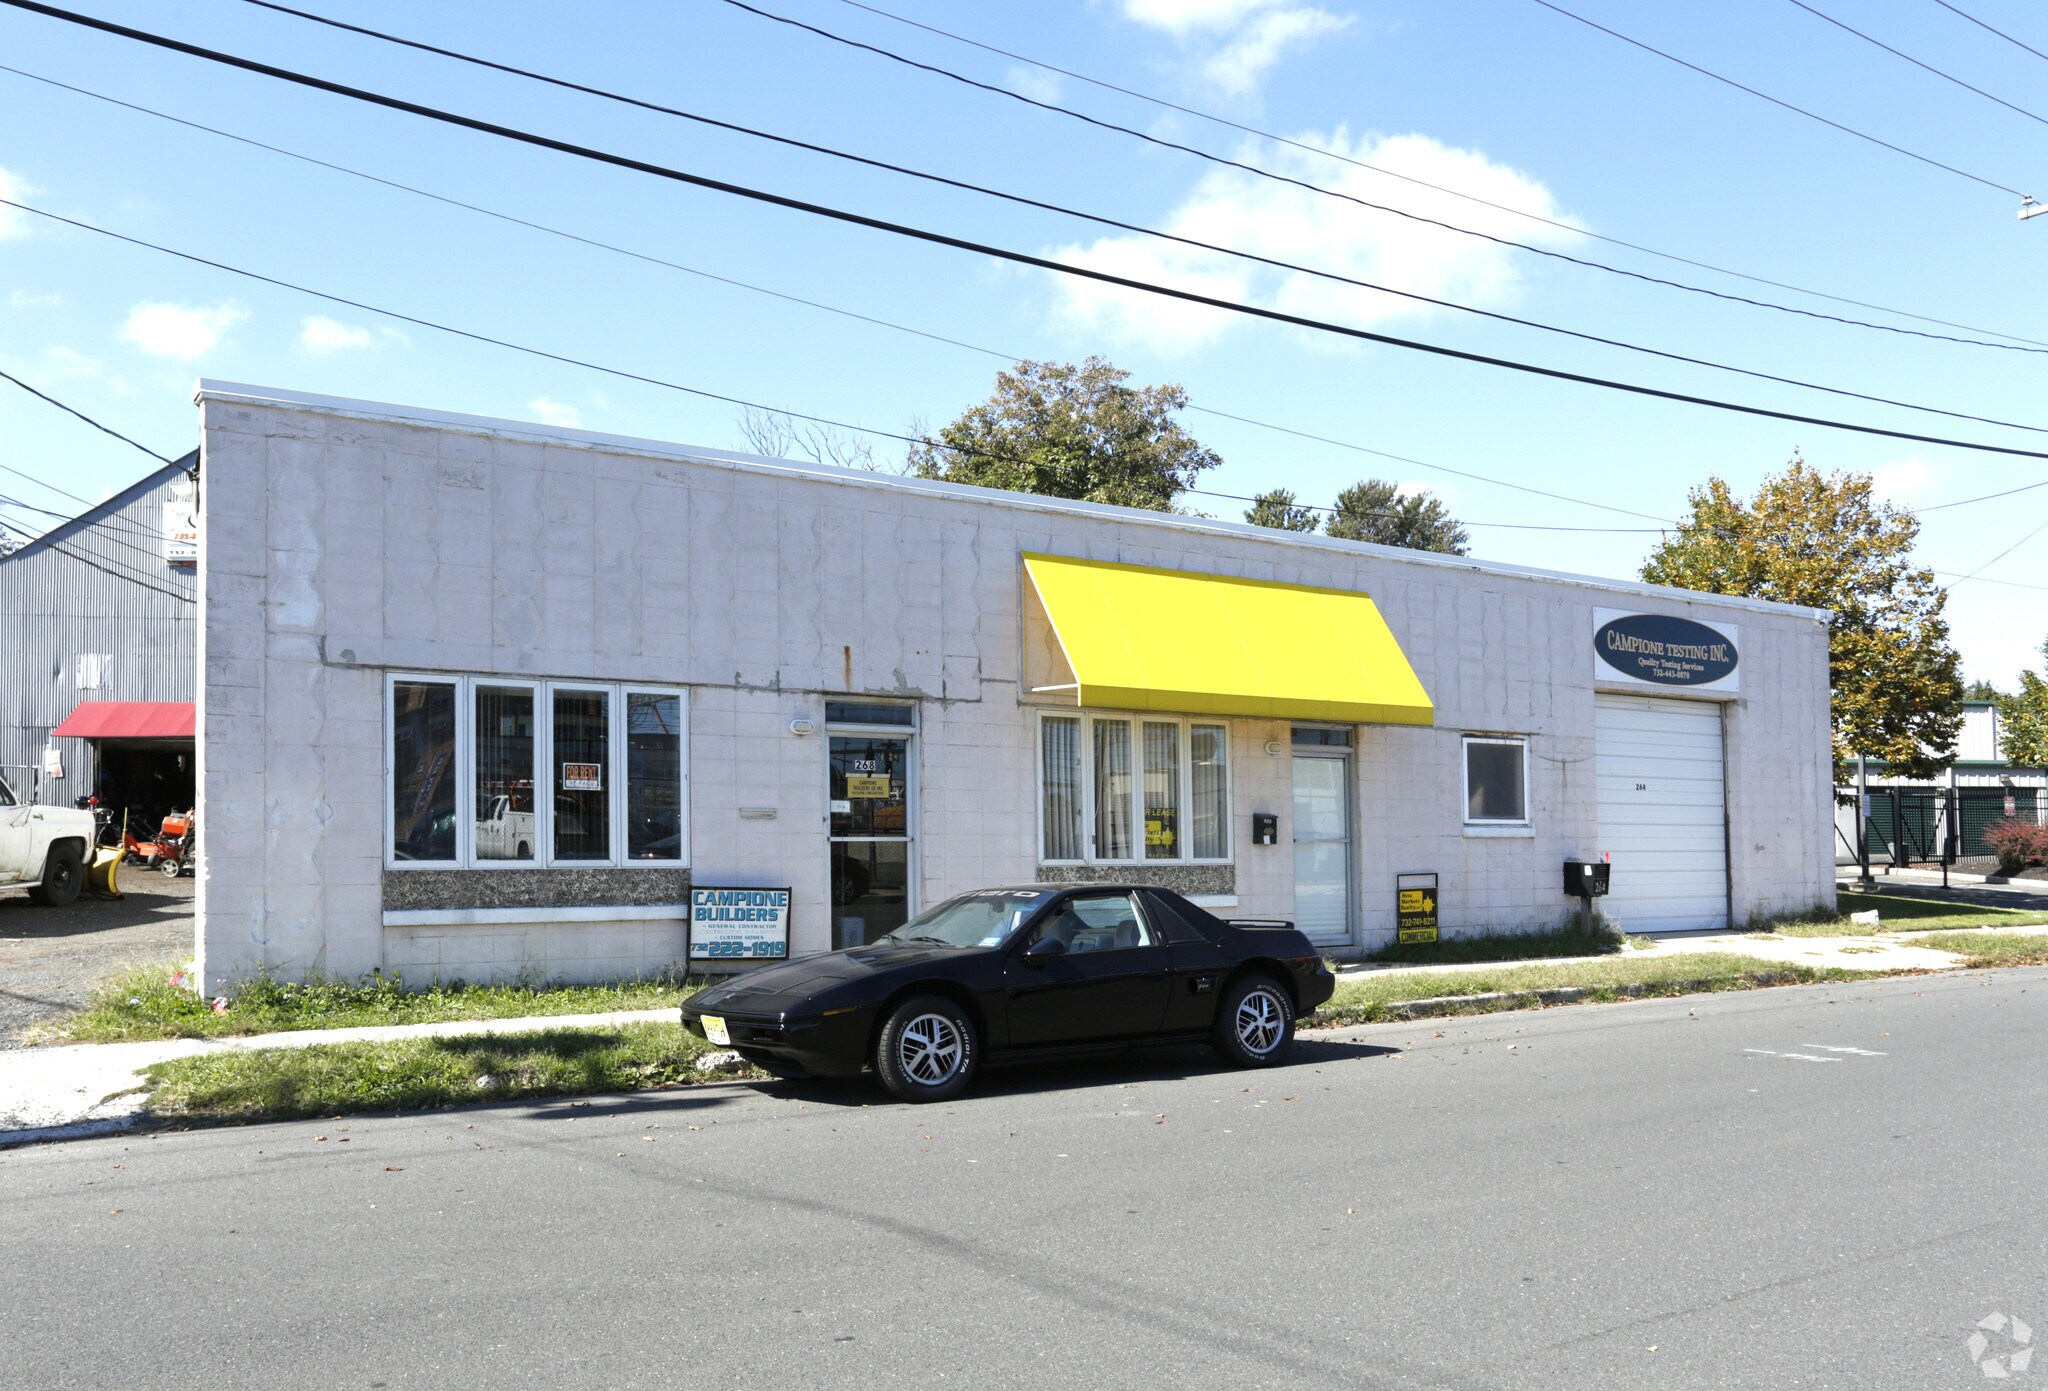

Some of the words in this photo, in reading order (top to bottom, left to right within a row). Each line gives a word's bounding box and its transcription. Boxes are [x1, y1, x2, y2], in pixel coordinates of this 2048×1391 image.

[1607, 630, 1664, 655] CAMPIONE
[1666, 644, 1708, 660] TESTING
[1709, 644, 1729, 662] INC.
[1638, 657, 1660, 668] Quality
[1661, 659, 1681, 670] Testing
[1682, 662, 1704, 671] Services
[856, 760, 874, 769] 268
[567, 765, 579, 779] FOR
[580, 766, 597, 780] RENT
[693, 891, 787, 906] CAMPIONE
[695, 907, 778, 921] BUILDERS
[1401, 918, 1435, 926] 732-741-8211
[1401, 931, 1436, 942] COMMERCIAL
[690, 943, 708, 952] 732
[708, 941, 785, 957] 222-1919
[956, 1019, 970, 1055] Radial
